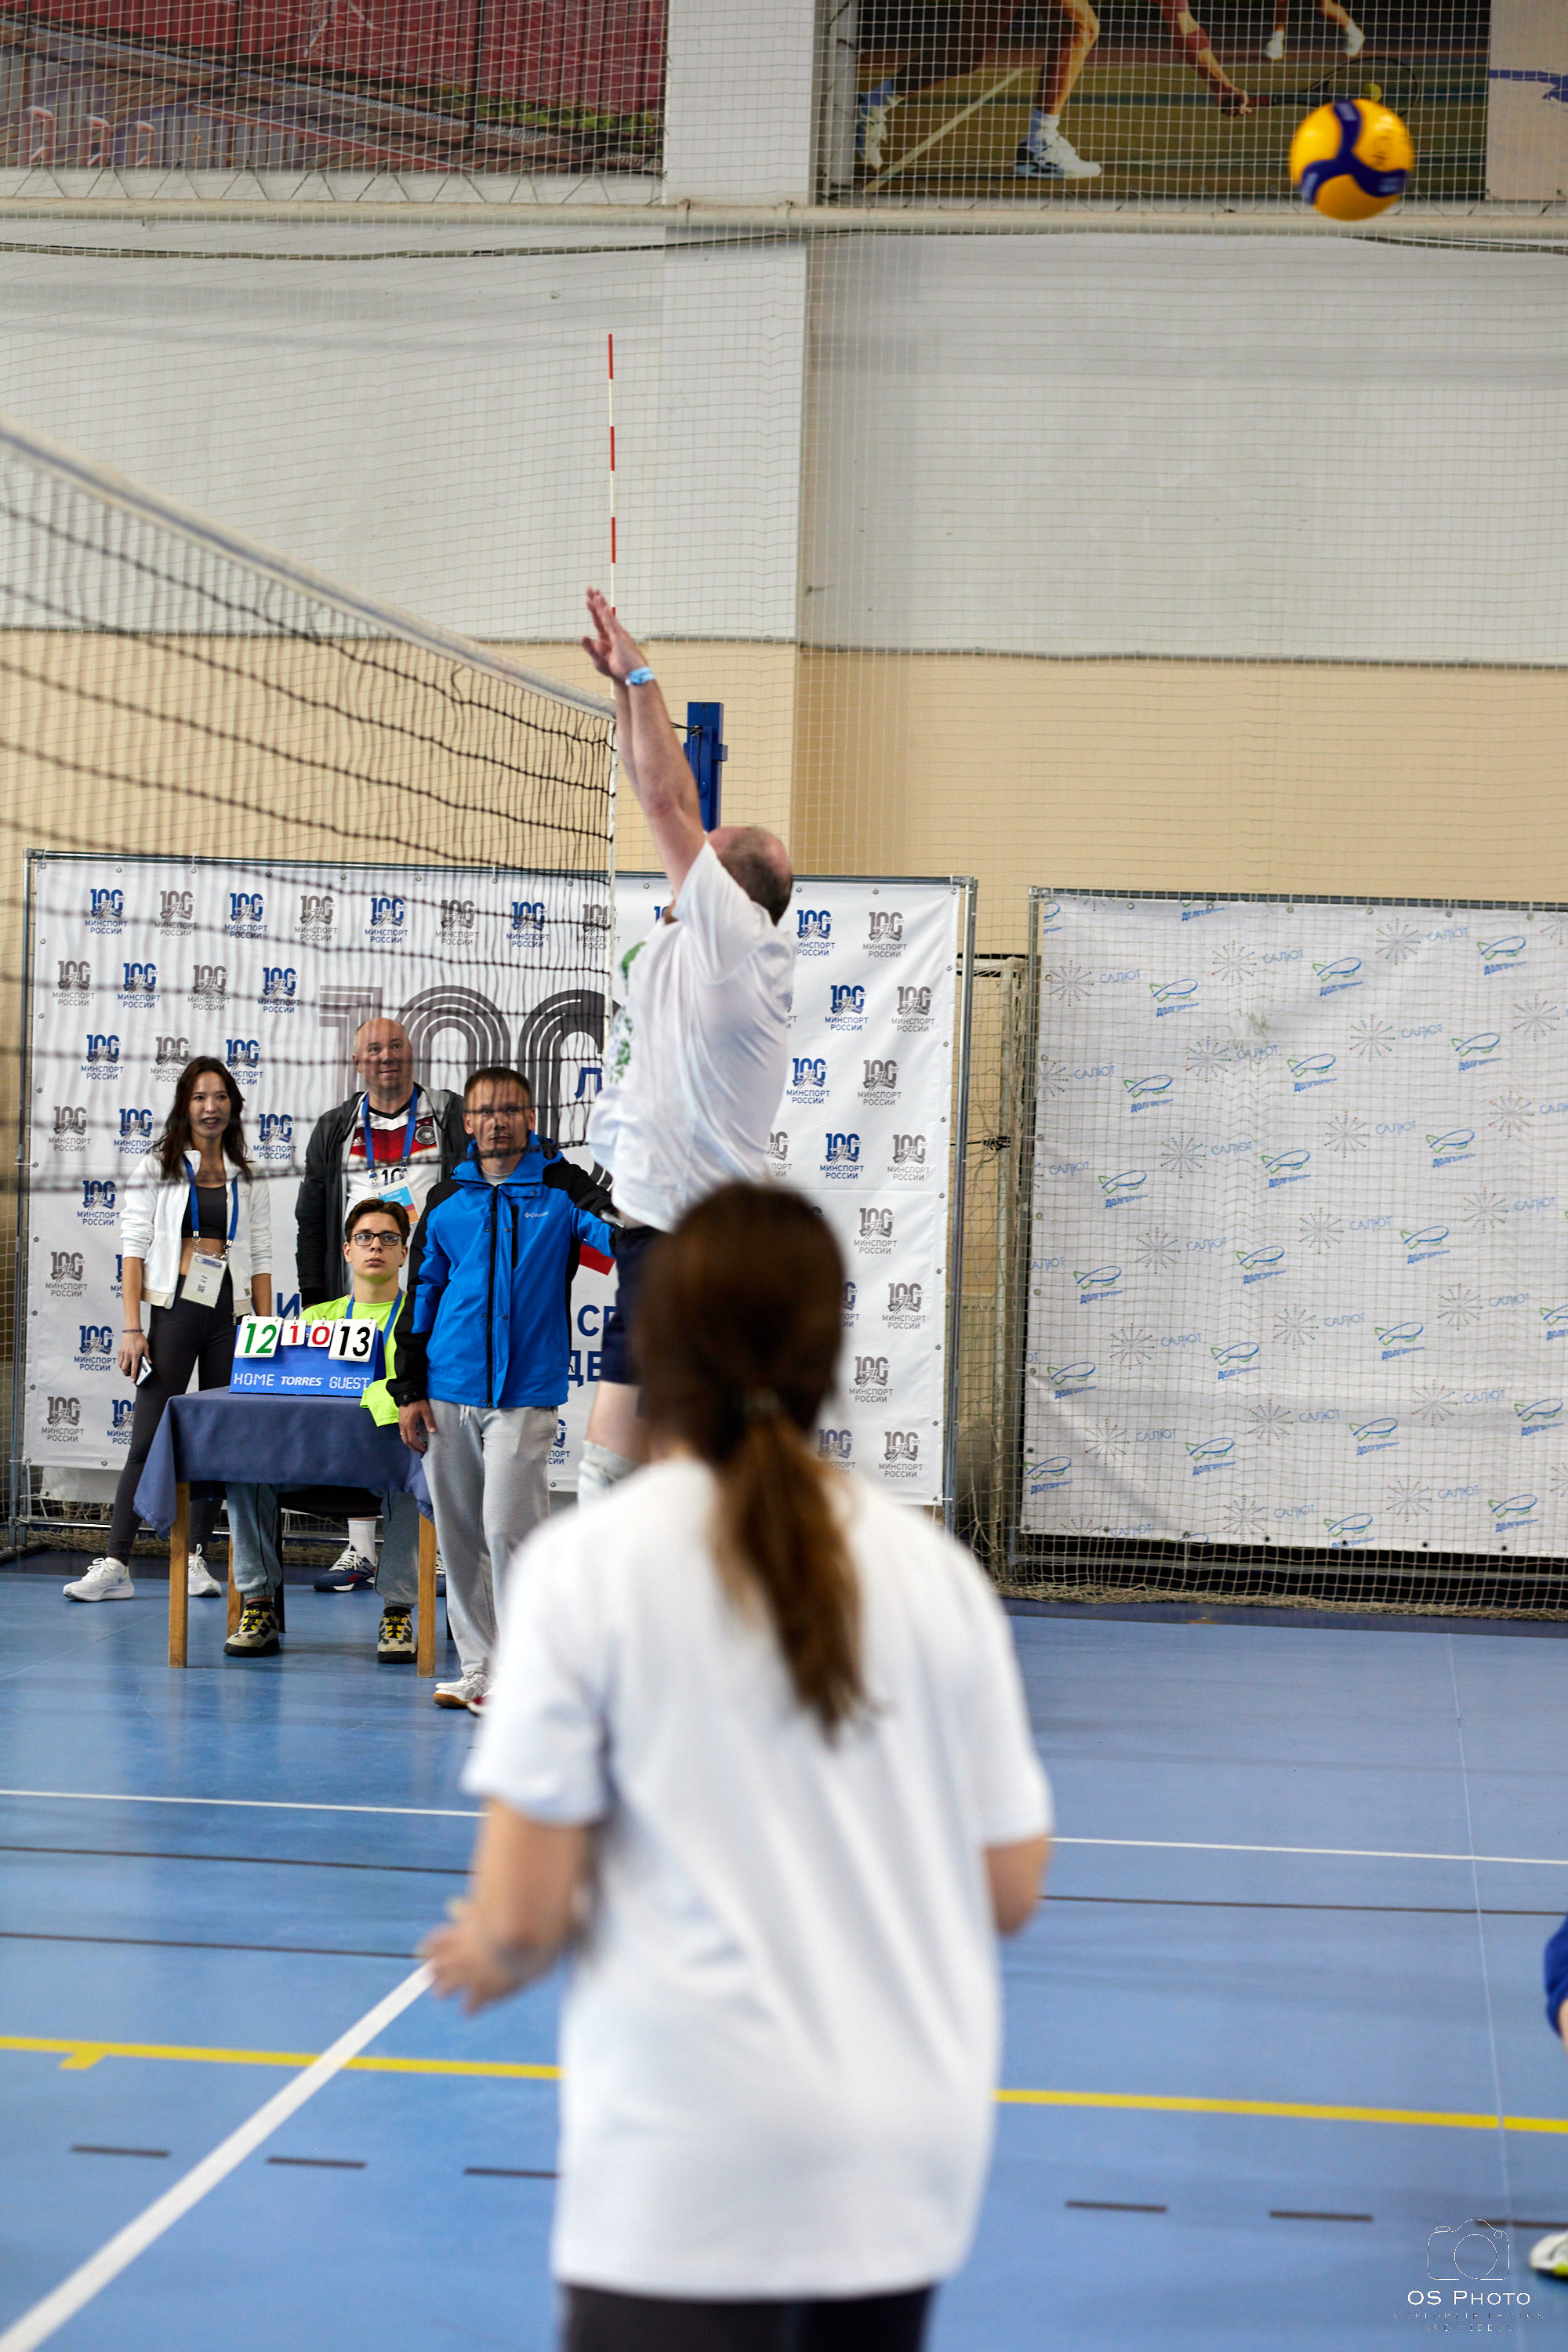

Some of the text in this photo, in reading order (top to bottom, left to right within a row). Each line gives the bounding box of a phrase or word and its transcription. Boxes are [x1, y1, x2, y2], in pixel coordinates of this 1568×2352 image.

[90, 888, 123, 915] 100
[230, 892, 263, 919] 100
[300, 895, 333, 921] 100
[371, 897, 404, 924] 100
[512, 902, 545, 928] 100
[797, 909, 831, 937] 100
[869, 911, 903, 938] 100
[58, 960, 91, 987] 100
[123, 962, 156, 989] 100
[830, 985, 865, 1012] 100
[897, 985, 931, 1013] 100
[86, 1034, 119, 1061] 100
[156, 1036, 189, 1063] 100
[226, 1039, 259, 1065] 100
[230, 1069, 264, 1078] НСПОРТ
[792, 1058, 826, 1085] 100
[863, 1059, 898, 1087] 100
[53, 1105, 86, 1132] 100
[119, 1108, 152, 1134] 100
[259, 1113, 292, 1140] 100
[826, 1133, 860, 1160] 100
[892, 1134, 927, 1162] 100
[82, 1180, 115, 1207] 100
[858, 1207, 893, 1235] 100
[50, 1251, 83, 1278] 100
[1031, 1257, 1064, 1272] АЛЮТ
[887, 1283, 922, 1310] 100
[79, 1325, 112, 1352] 100
[245, 1323, 371, 1356] 12 1 0 13
[234, 1373, 371, 1389] HOME TORRES GUEST
[854, 1356, 888, 1384] 100
[47, 1396, 80, 1423] 100
[112, 1399, 136, 1424] 10
[884, 1431, 919, 1458] 100
